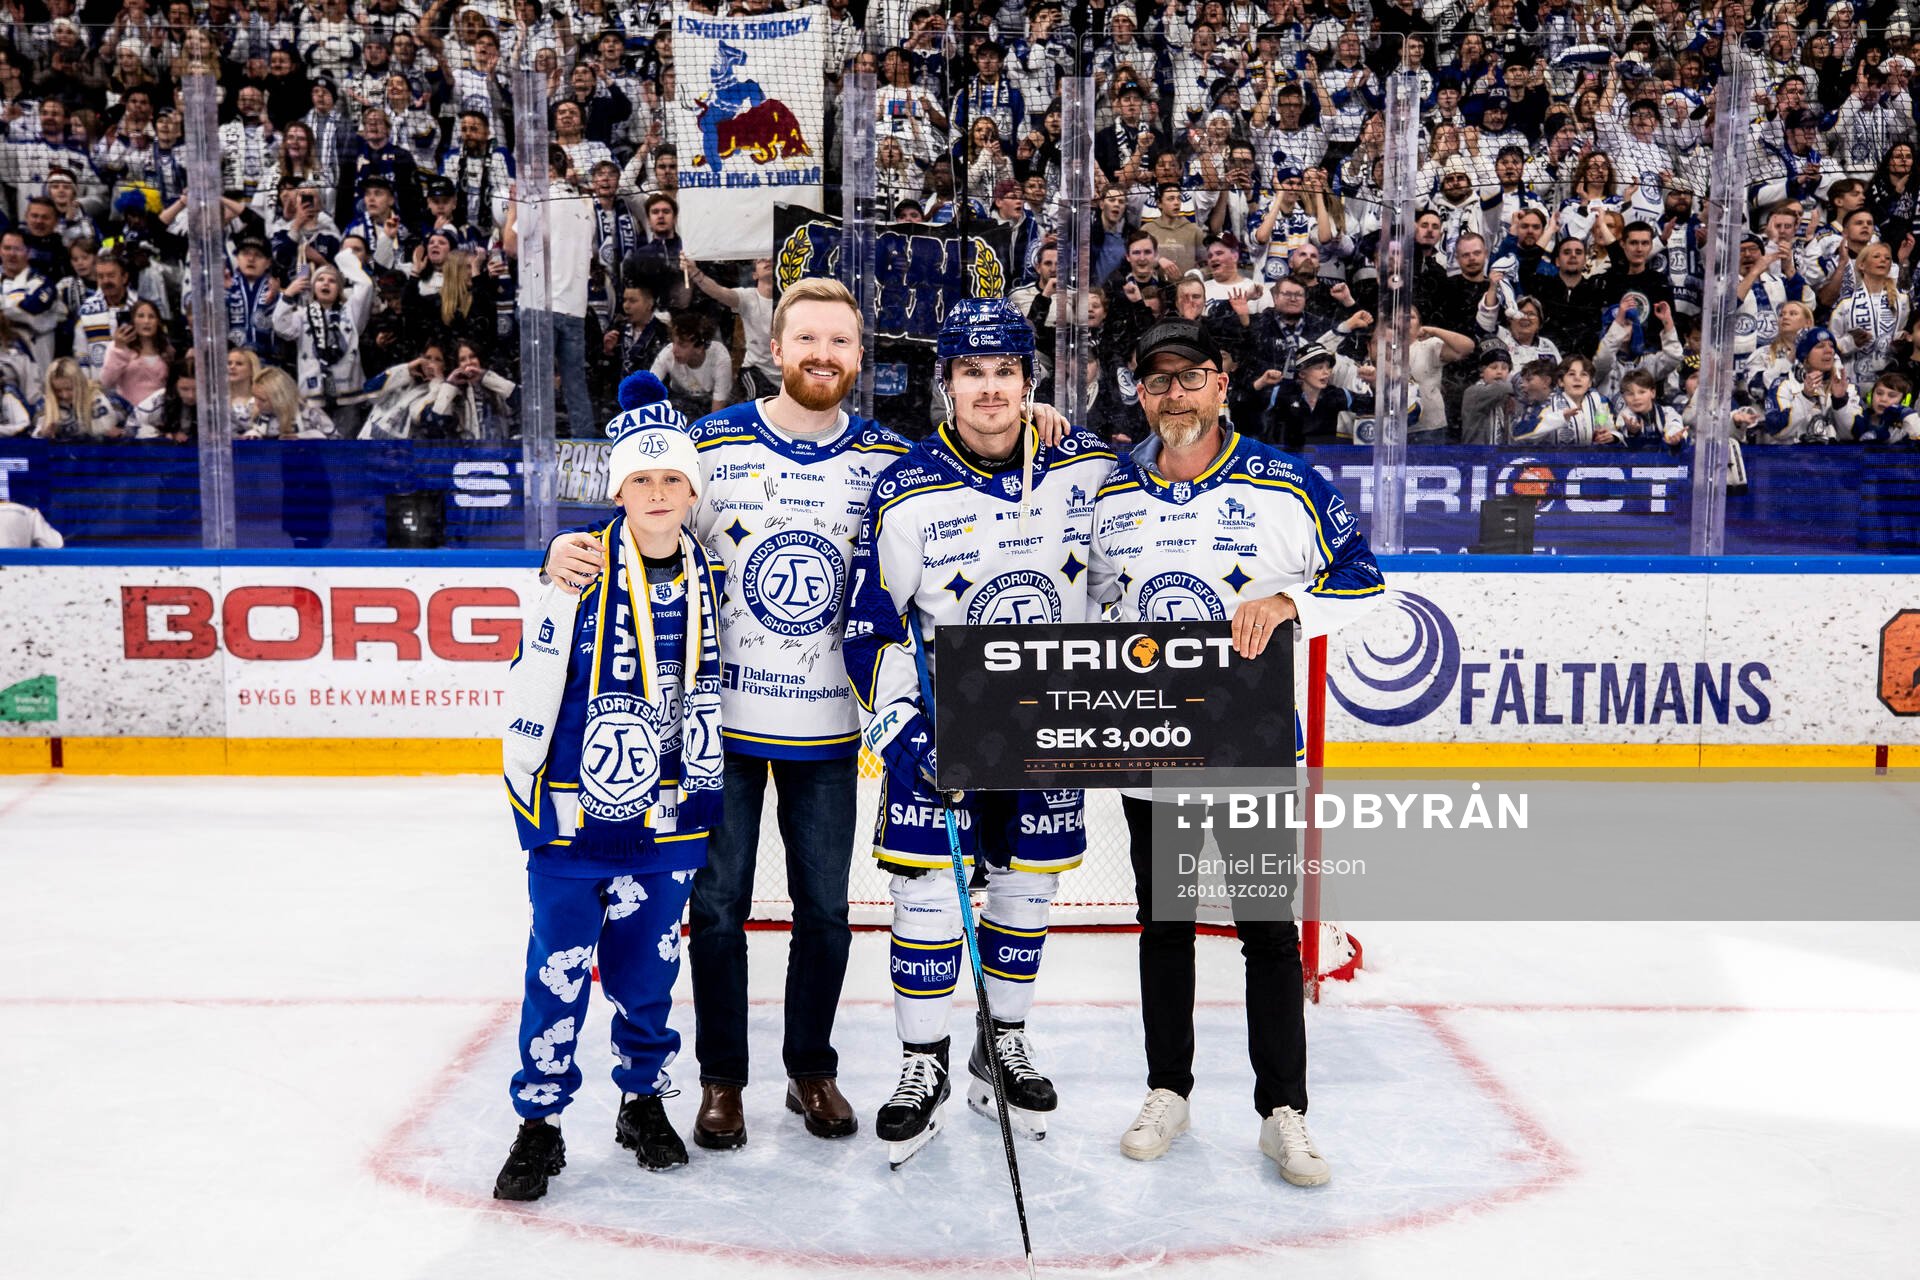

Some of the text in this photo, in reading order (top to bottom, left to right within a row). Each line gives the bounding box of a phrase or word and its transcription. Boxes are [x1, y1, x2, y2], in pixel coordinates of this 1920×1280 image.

[686, 18, 740, 40] SVENSK
[744, 15, 812, 40] ISHOCKEY
[705, 418, 730, 427] Clas
[706, 424, 744, 436] Ohlson
[757, 425, 779, 447] TEGERA
[938, 451, 968, 477] TEGERA
[1219, 456, 1241, 476] TEGERA
[1268, 459, 1293, 470] Clas
[790, 471, 825, 482] TEGERA
[896, 466, 924, 479] Clas
[900, 473, 942, 487] Ohlson
[1001, 474, 1019, 483] SHL
[1266, 467, 1303, 484] Ohlson
[1002, 481, 1022, 495] 50
[1172, 488, 1191, 500] 50
[739, 502, 763, 511] HEDIN
[1006, 507, 1043, 520] TERA
[938, 513, 977, 529] Bergkvist
[1217, 519, 1256, 528] LEKSANDS
[939, 527, 962, 541] Siljan
[1213, 543, 1258, 552] dalakraft
[924, 548, 980, 569] Hedmans
[744, 540, 776, 606] LEKSANDS
[655, 587, 672, 600] 50
[850, 568, 867, 608] 7
[656, 610, 682, 618] TEGERA
[120, 585, 523, 662] BORG
[759, 613, 825, 635] ISHOCKEY
[541, 626, 551, 641] IS
[743, 665, 806, 685] Dalarnas
[741, 679, 850, 702] Försäkringsbolag
[1459, 648, 1772, 725] FÄLTMANS
[239, 688, 505, 708] BYGG BEKYMMERSFRIT
[1046, 689, 1177, 710] TRAVEL
[509, 717, 545, 738] AEB
[1036, 724, 1192, 752] SEK 3,000
[1053, 760, 1178, 769] TRE TUSEN KRONOR
[579, 790, 655, 819] ISHOCKEY
[953, 855, 967, 895] BAUER
[923, 973, 953, 983] ELECTRO
